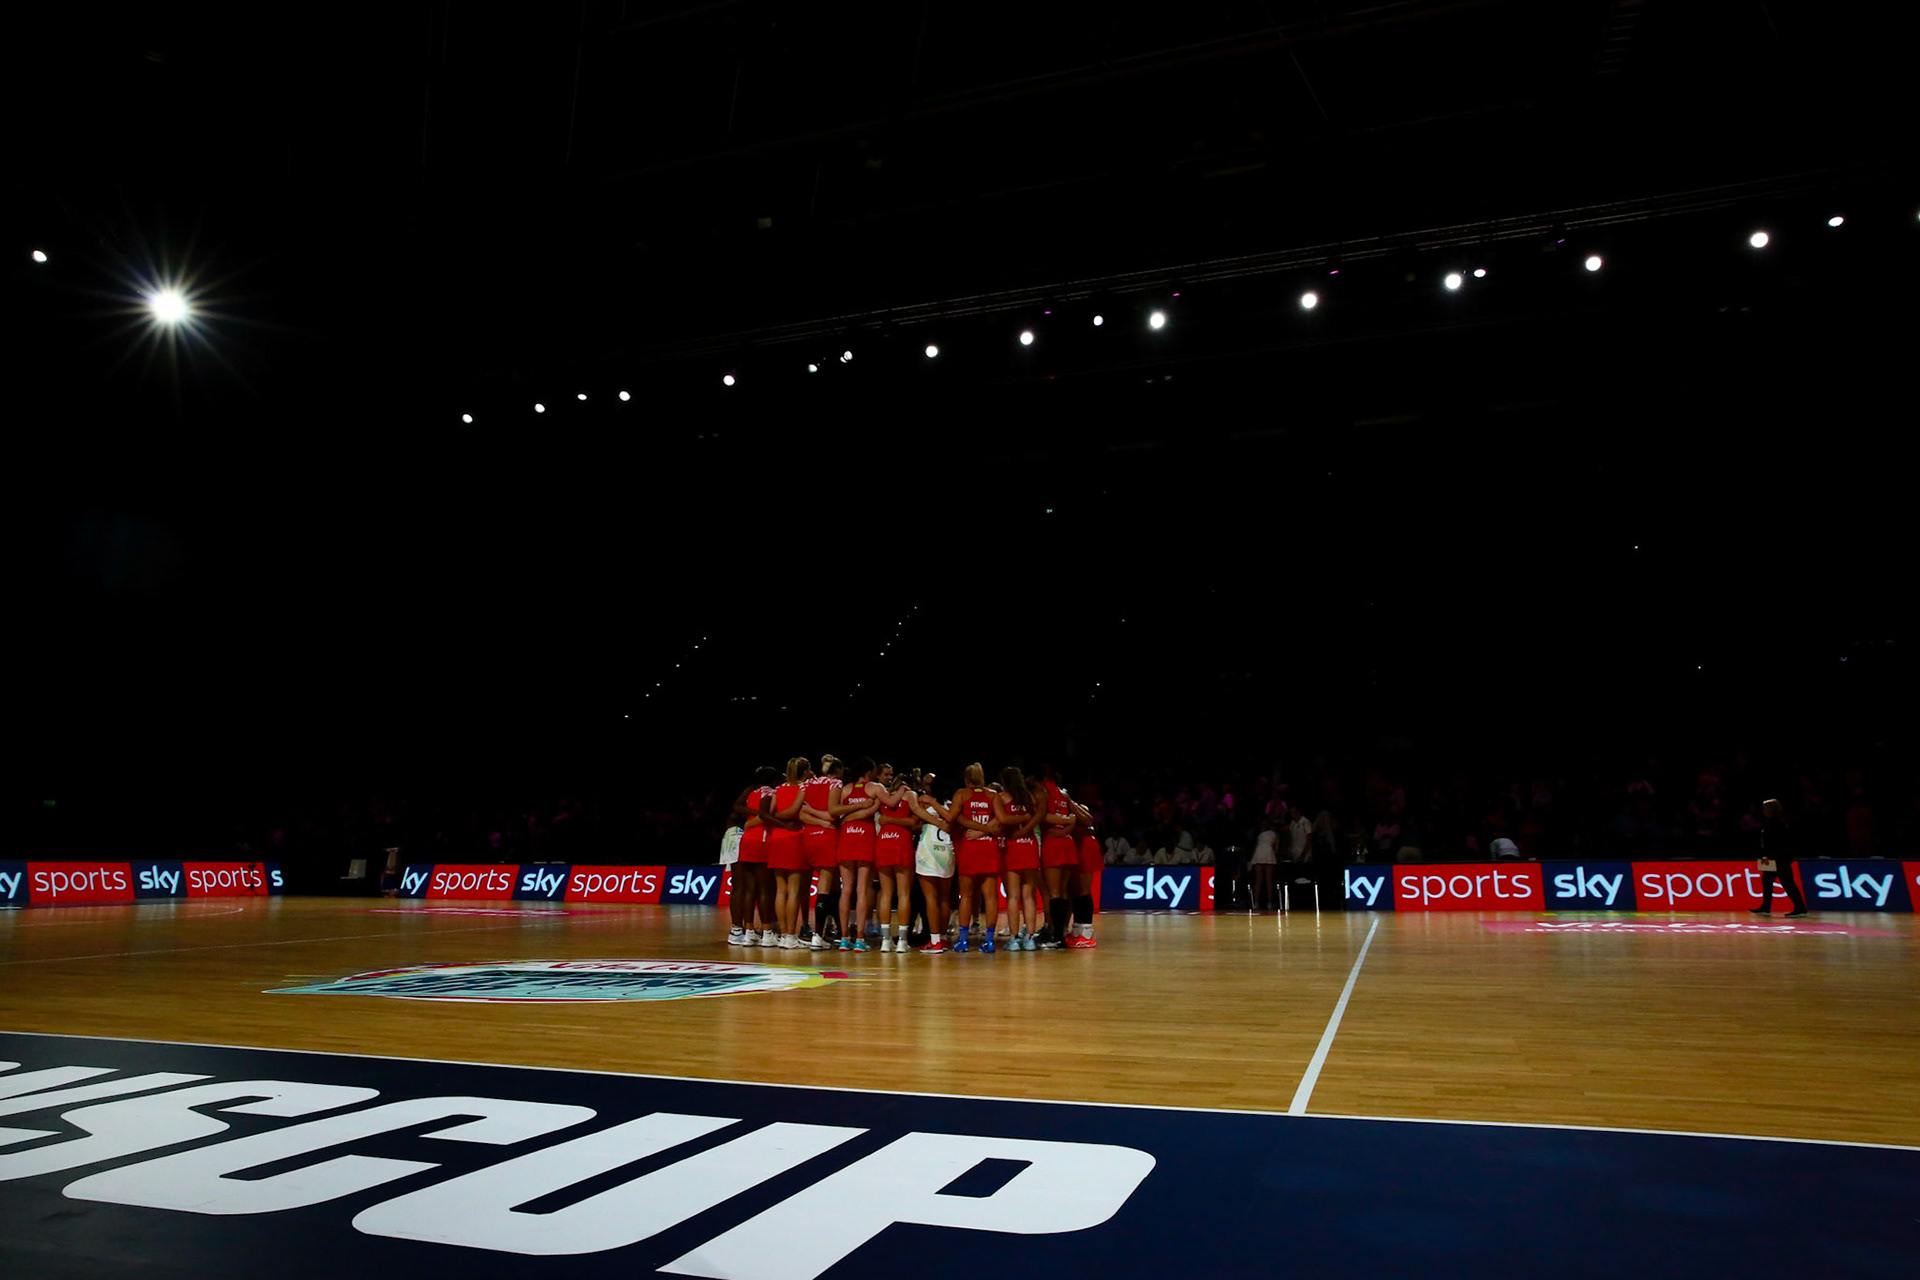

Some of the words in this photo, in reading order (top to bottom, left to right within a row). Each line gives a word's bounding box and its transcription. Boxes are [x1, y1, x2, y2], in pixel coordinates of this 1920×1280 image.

[35, 867, 127, 898] sports
[140, 865, 181, 895] sky
[190, 866, 262, 893] sports
[433, 869, 511, 895] sports
[521, 867, 566, 898] sky
[571, 870, 657, 898] sports
[668, 868, 717, 901] sky
[1123, 867, 1192, 908] sky
[1401, 869, 1532, 906] sports
[1553, 866, 1624, 906] sky
[1815, 865, 1895, 907] sky
[320, 982, 518, 993] CUP
[394, 975, 746, 988] NATIONS
